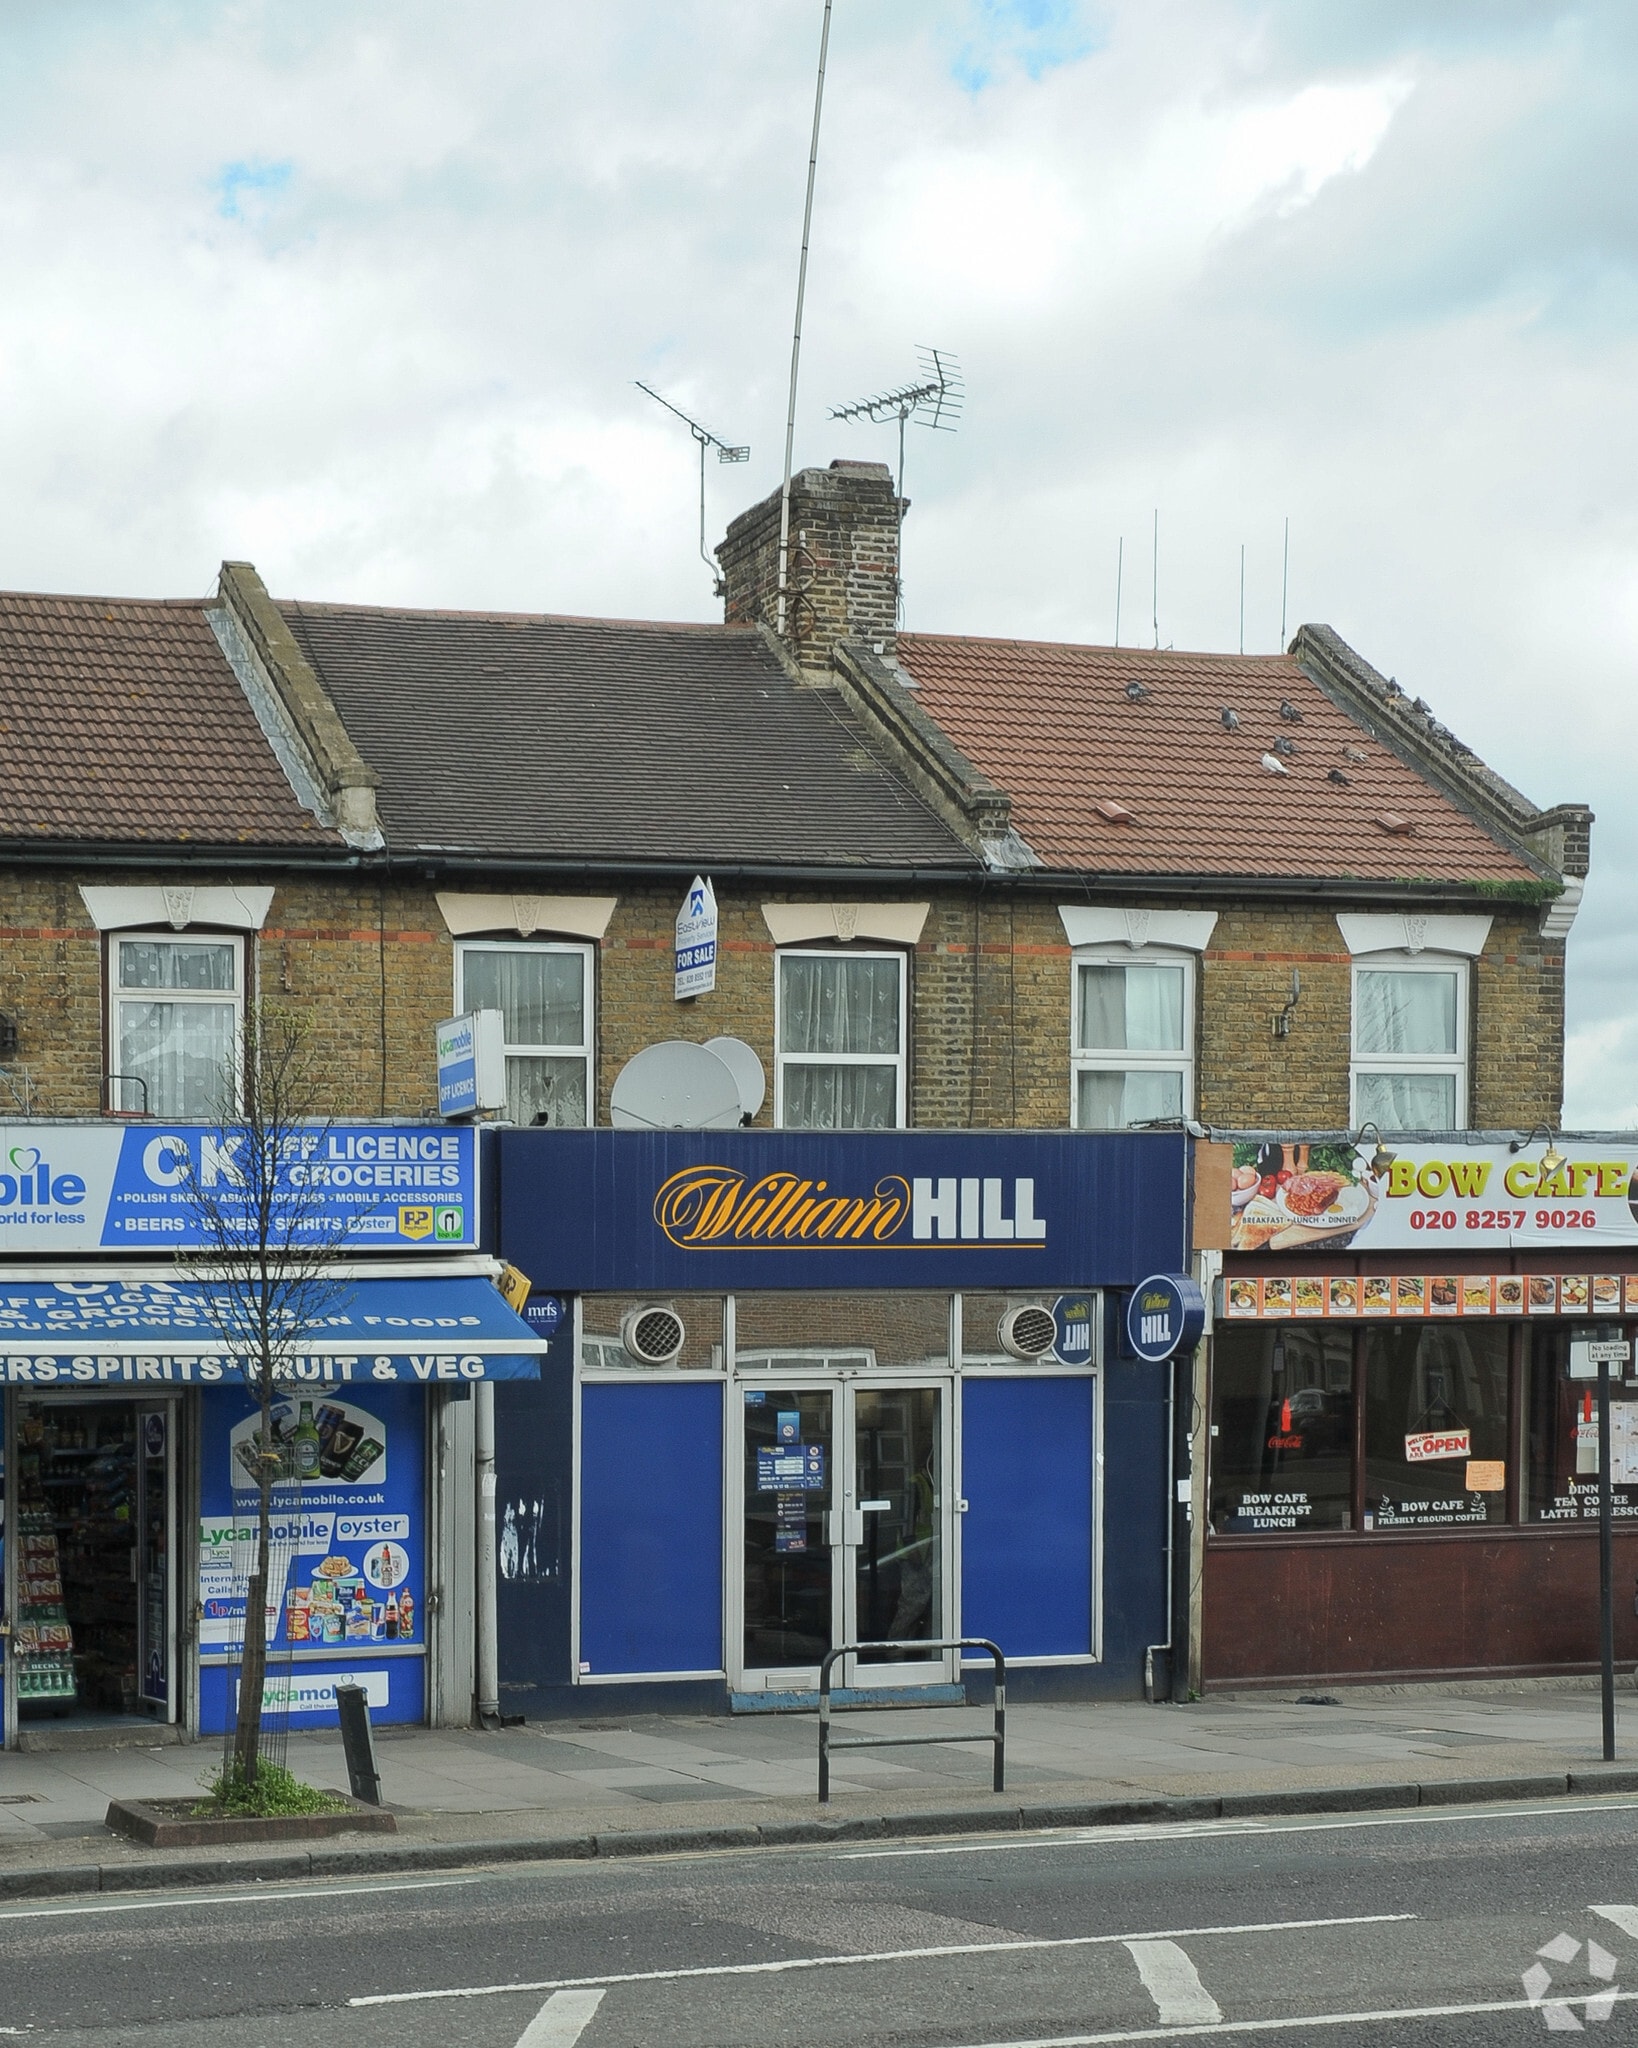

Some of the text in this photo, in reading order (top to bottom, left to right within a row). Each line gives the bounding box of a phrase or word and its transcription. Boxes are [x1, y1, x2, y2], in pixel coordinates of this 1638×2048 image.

[677, 944, 714, 969] FOR SALE
[441, 1077, 475, 1102] OFF LICENCE
[328, 1136, 460, 1161] LICENCE
[142, 1135, 248, 1188] CK
[289, 1164, 461, 1187] GROCERIES
[1386, 1160, 1630, 1199] BOW CAFE
[123, 1193, 167, 1204] POLISH
[335, 1192, 464, 1204] MOBILE ACCESSORIES
[653, 1164, 1047, 1244] William HILL
[31, 1211, 53, 1225] for
[54, 1211, 86, 1225] less
[124, 1217, 186, 1232] BEERS
[201, 1217, 260, 1232] WNES
[274, 1217, 343, 1232] SPIRITS
[349, 1218, 392, 1232] oyster
[1242, 1215, 1359, 1225] BREAKFAST LUNCH DINNER
[1409, 1209, 1597, 1230] 020 8257 9026
[0, 1292, 262, 1309] FF-LICENCE
[527, 1301, 558, 1317] mrfs
[363, 1315, 482, 1328] FOODS
[1141, 1313, 1172, 1345] HILL
[1603, 1344, 1627, 1352] loading
[1600, 1352, 1611, 1360] any
[371, 1356, 398, 1380] &
[409, 1356, 485, 1379] VEG
[1422, 1436, 1468, 1454] OPEN
[1242, 1493, 1308, 1504] BOW CAFE
[1554, 1495, 1629, 1507] TEA COEE
[1237, 1505, 1313, 1516] BREAKFAST
[1401, 1500, 1465, 1512] BOW CAFE
[1540, 1506, 1638, 1519] LATTE ESESSO
[1253, 1517, 1297, 1528] LUNCH
[1378, 1513, 1487, 1525] FRESHLY GROUND COFFEE
[340, 1518, 400, 1538] oyster
[200, 1572, 250, 1584] Internatio
[207, 1585, 232, 1595] Calls
